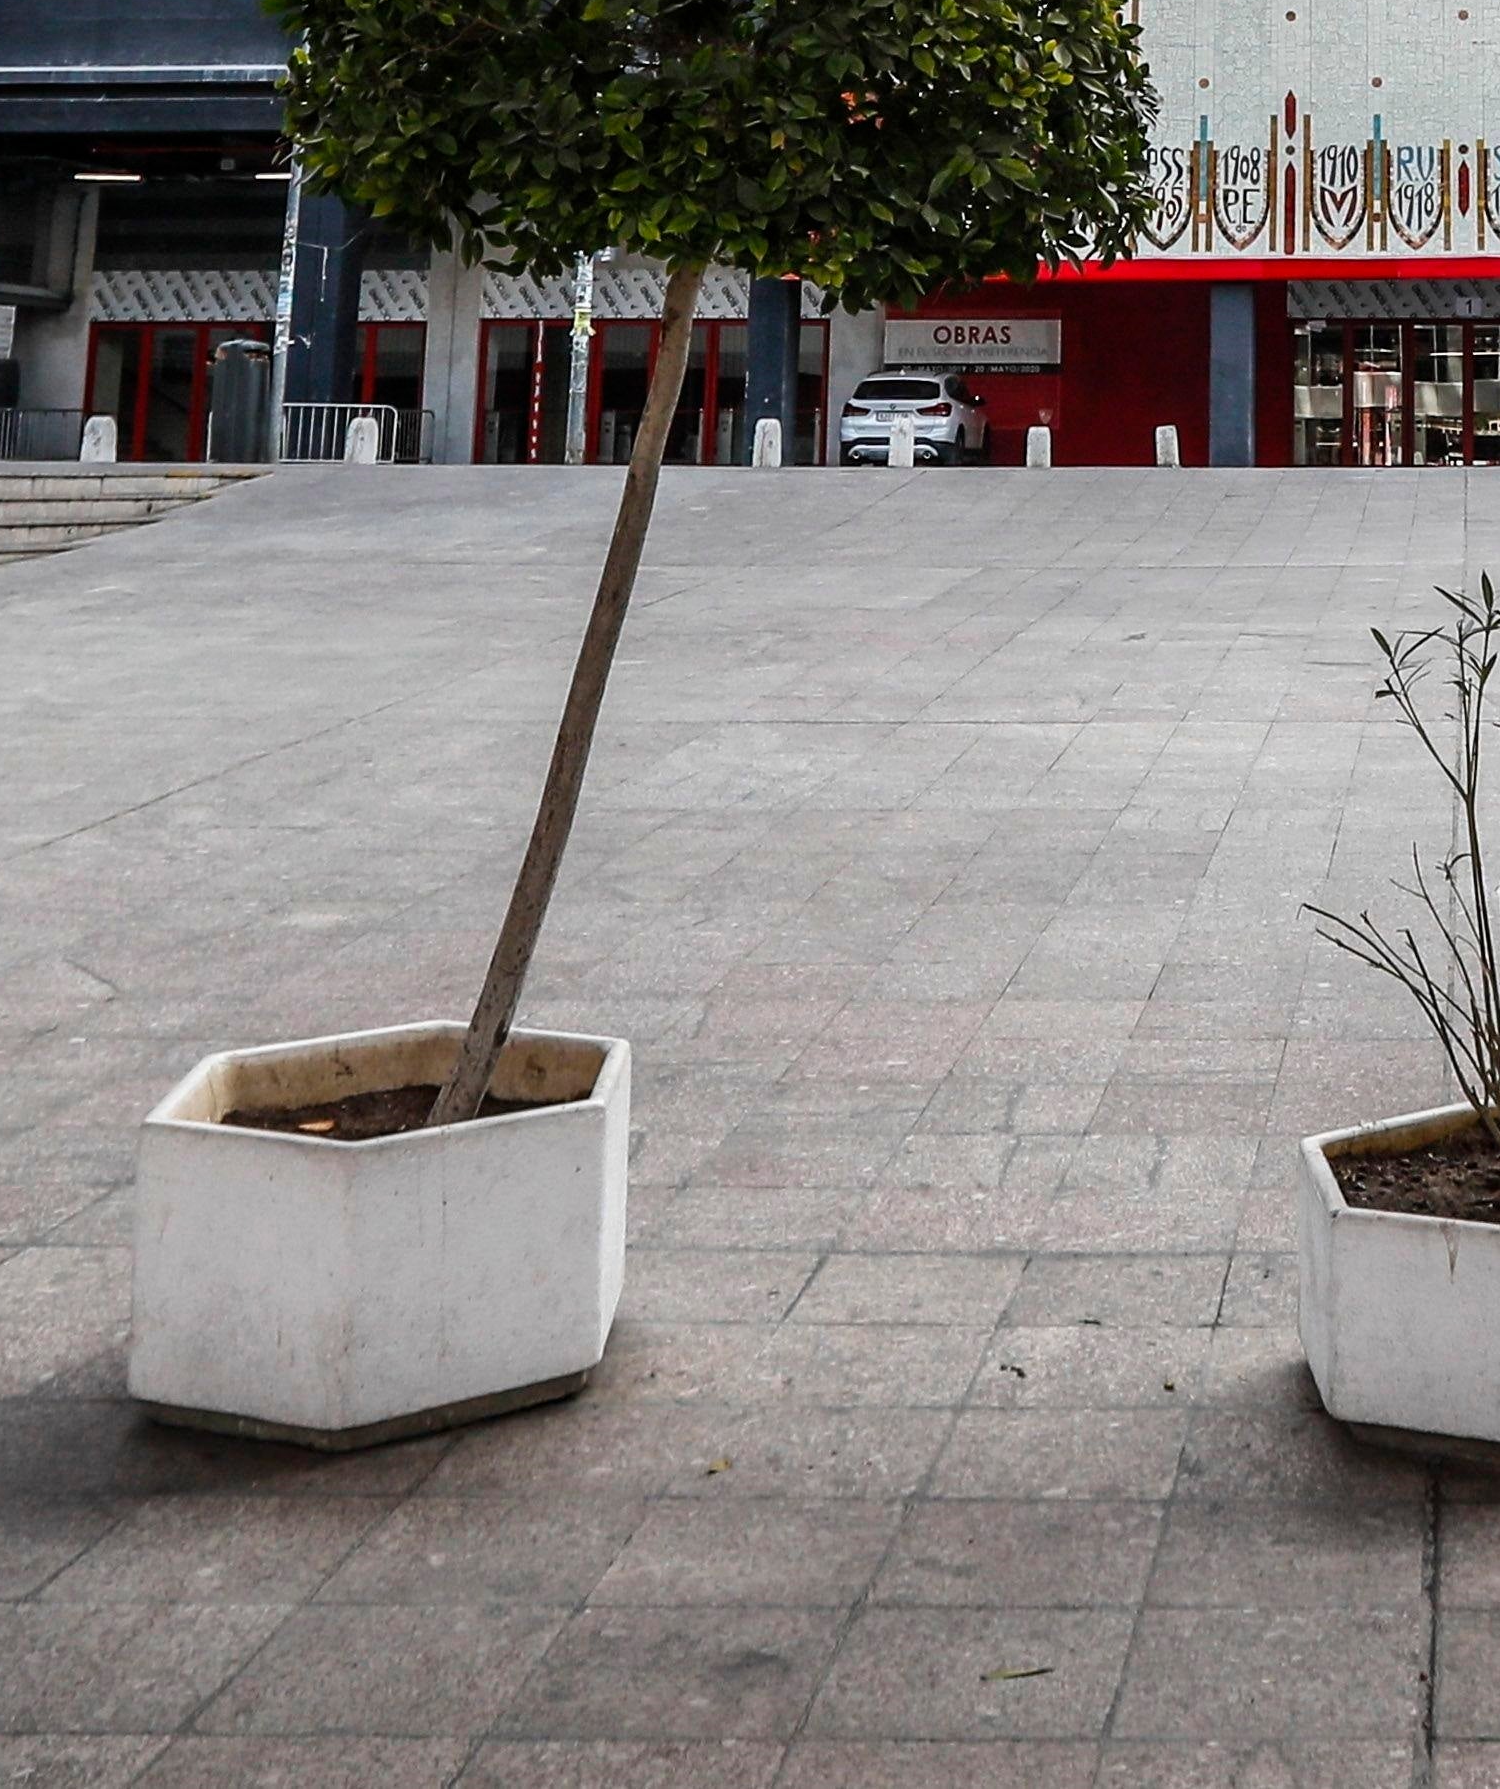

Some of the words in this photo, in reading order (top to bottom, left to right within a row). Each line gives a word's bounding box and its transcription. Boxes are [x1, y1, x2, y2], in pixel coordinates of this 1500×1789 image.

[1221, 145, 1260, 185] 1908
[1318, 144, 1358, 187] 1910
[1152, 186, 1184, 231] 905
[1319, 185, 1358, 227] M
[1395, 182, 1435, 231] 1918
[933, 325, 1011, 344] OBRAS
